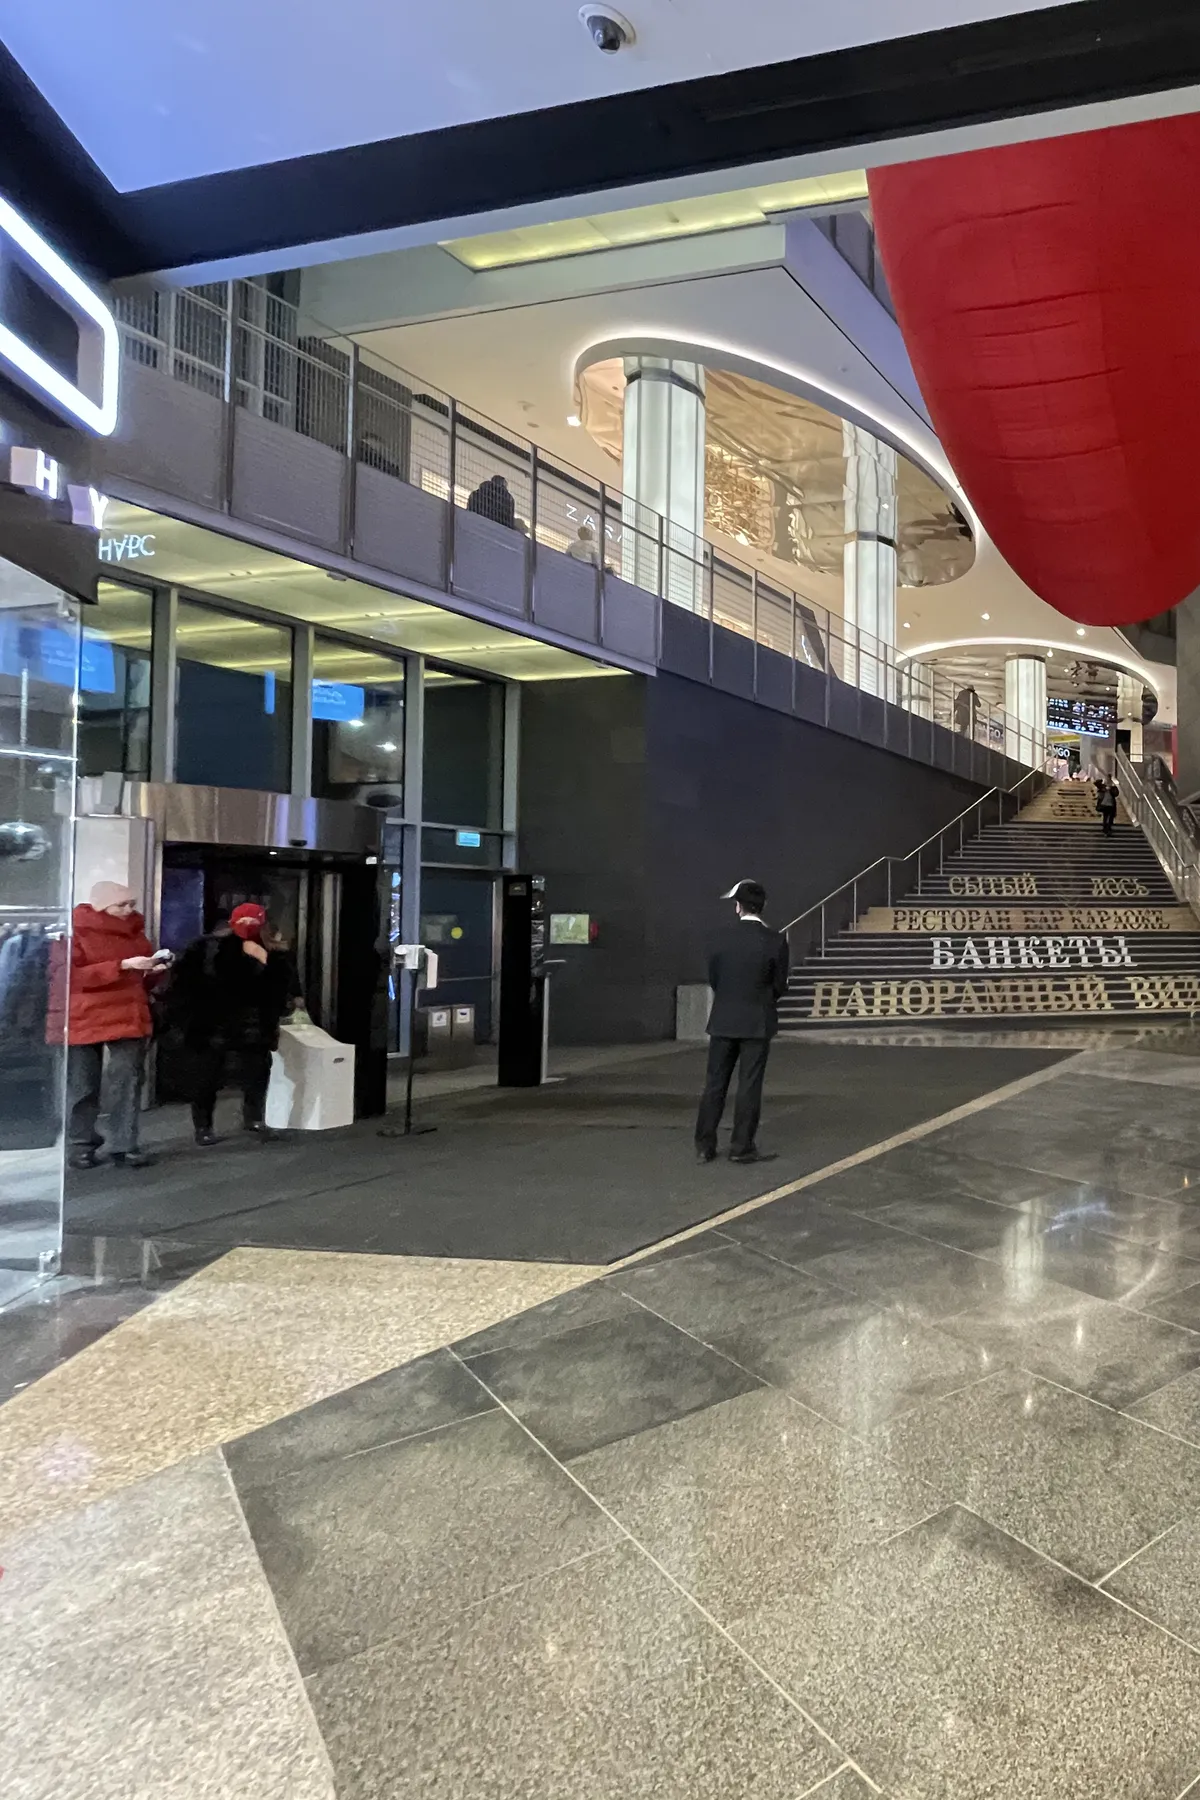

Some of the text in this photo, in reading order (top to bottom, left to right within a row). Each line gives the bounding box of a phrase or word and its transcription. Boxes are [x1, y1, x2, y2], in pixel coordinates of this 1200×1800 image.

[949, 872, 1038, 896] СЫТЫЙ
[891, 909, 1170, 931] РЕСТОРАН БАР КАРАОКЕ
[930, 935, 1138, 970] БАНКЕТЫ
[808, 974, 1114, 1018] ПАНОРАМНЫЙ
